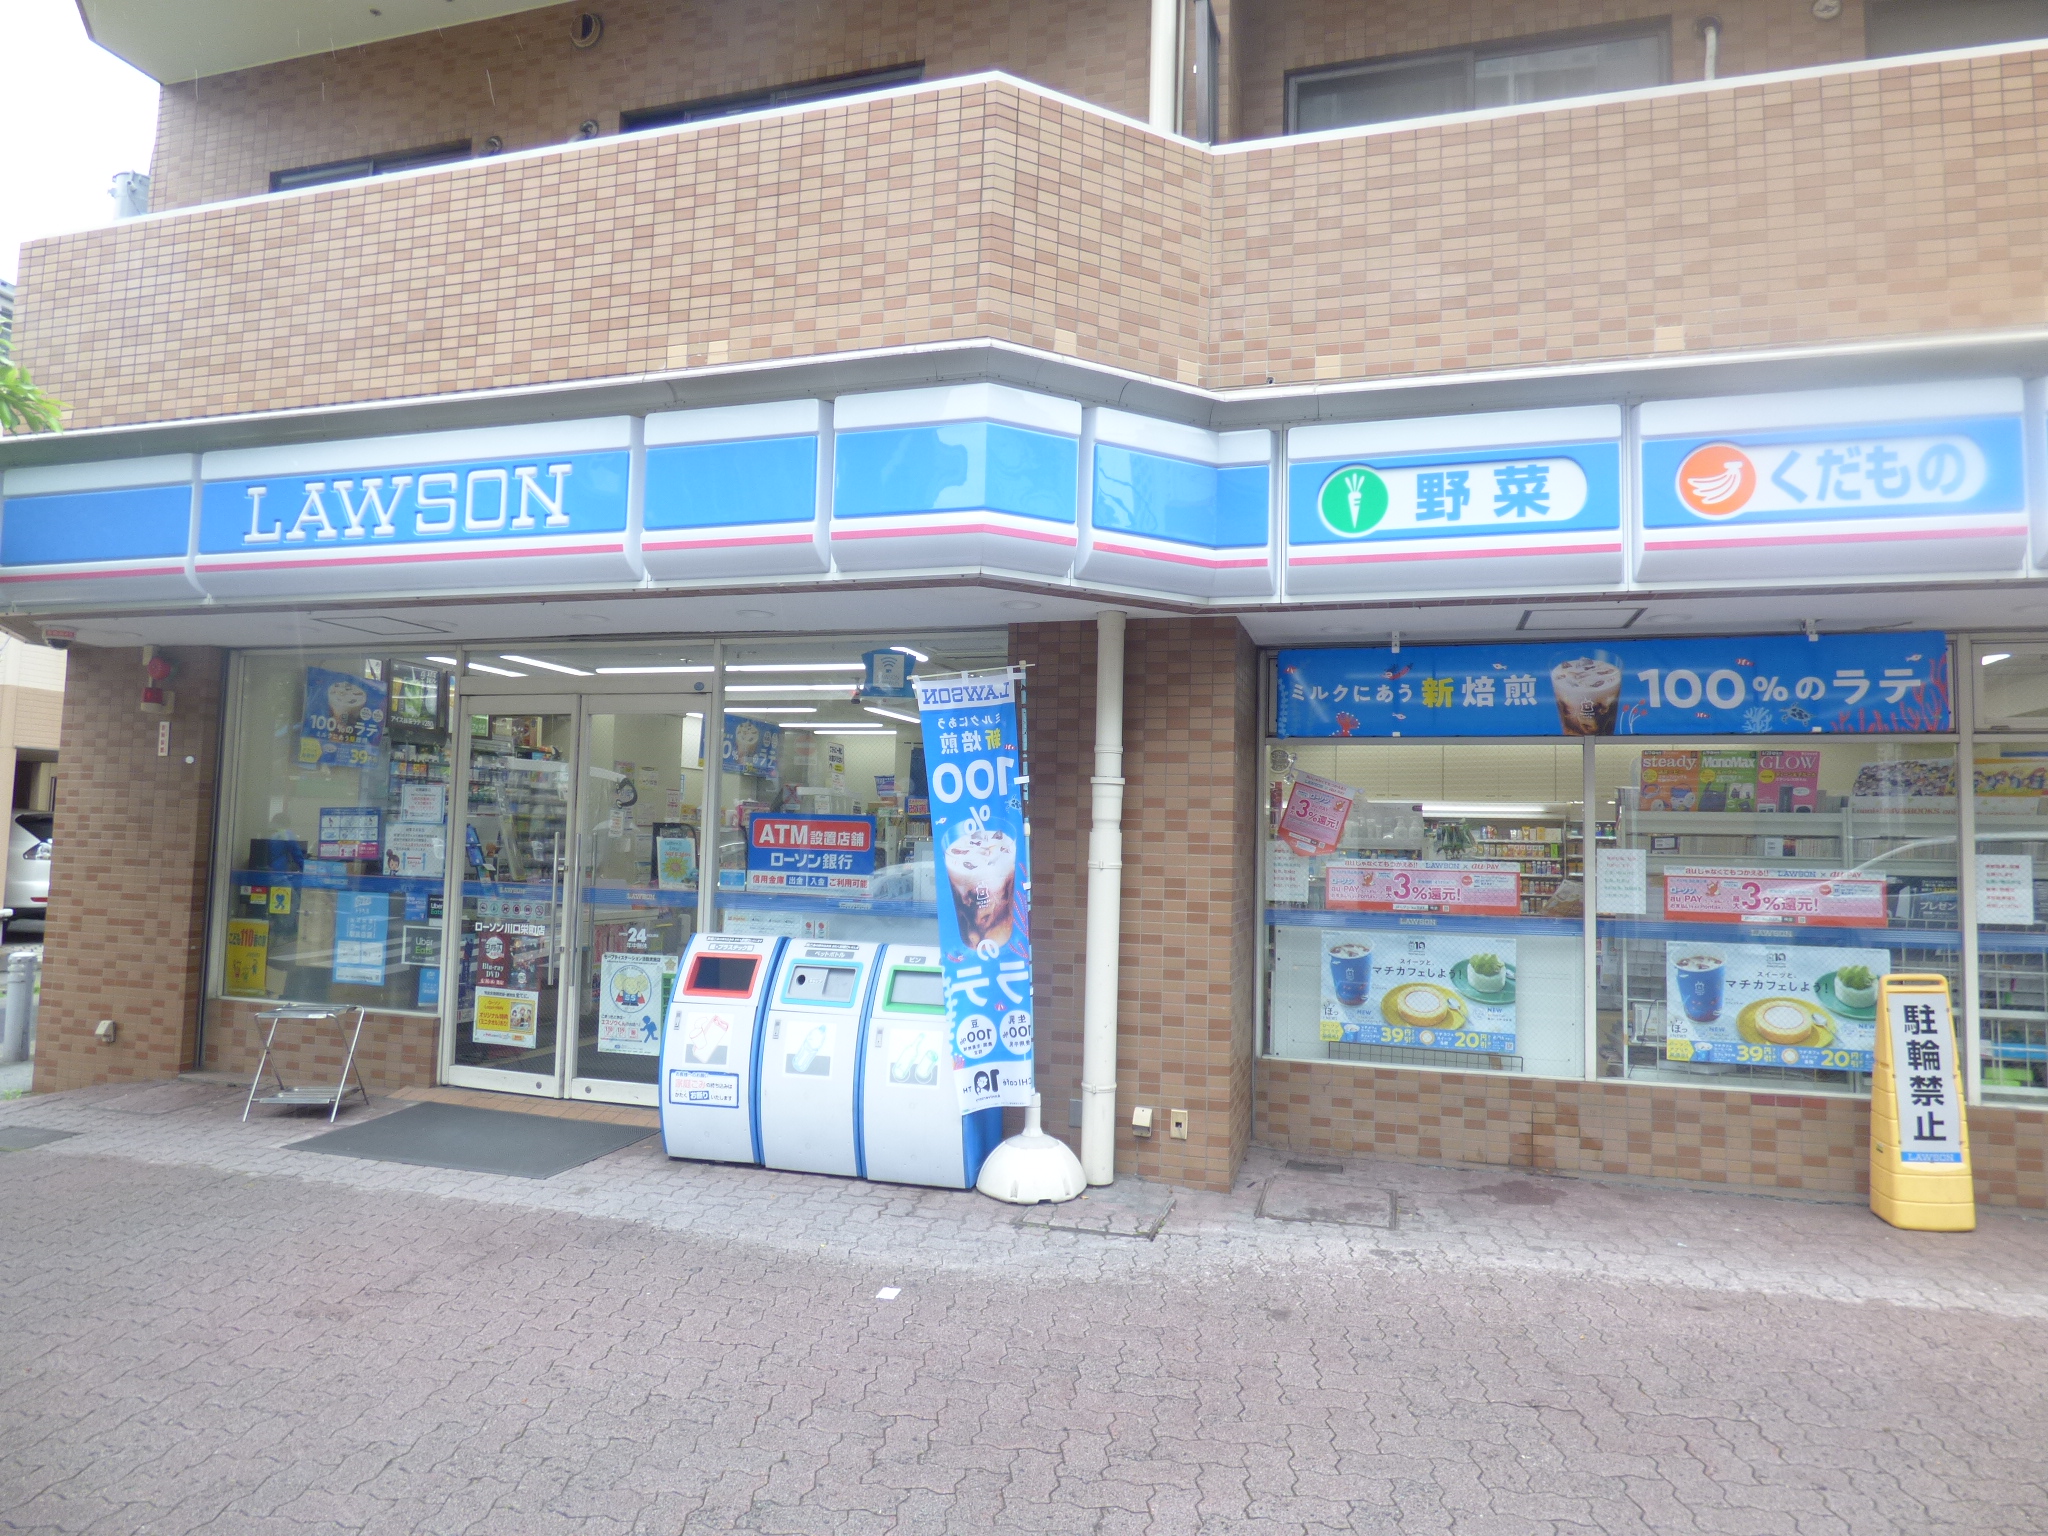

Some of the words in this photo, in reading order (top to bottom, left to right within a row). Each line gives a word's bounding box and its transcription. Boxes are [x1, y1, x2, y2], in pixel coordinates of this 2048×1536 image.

[1771, 444, 1967, 503] くだもの
[1415, 464, 1551, 521] 野菜
[243, 462, 573, 544] LAWSON
[1638, 668, 1921, 710] 100%のラテ
[1701, 756, 1755, 768] MonoMax
[1760, 755, 1816, 770] GLOW
[770, 853, 853, 870] ローソン銀行
[752, 874, 784, 886] 信用金庫
[788, 876, 804, 887] 出金
[809, 877, 825, 887] 入金
[829, 878, 869, 889] ご利用可能
[1684, 895, 1702, 903] PAY
[415, 936, 433, 946] Uber
[628, 927, 647, 942] 24
[415, 946, 433, 955] Eats
[1372, 966, 1462, 980] マチカフェしよう!
[1725, 979, 1829, 994] マチカフェしよう!
[1903, 1004, 1946, 1142] 駐輪禁止
[1907, 1153, 1954, 1162] LAWSON
